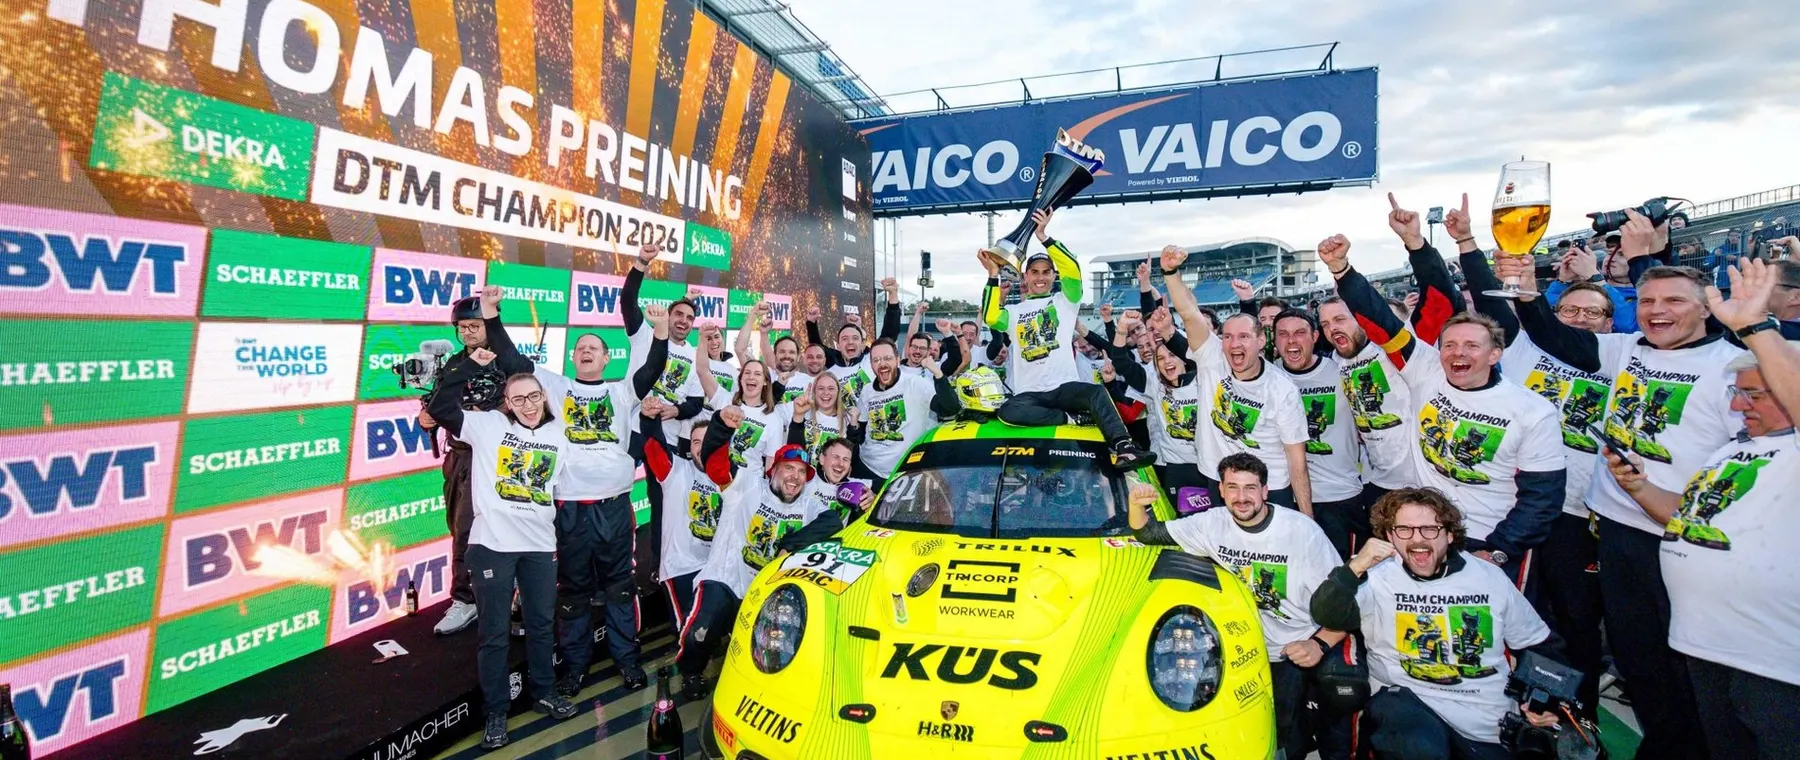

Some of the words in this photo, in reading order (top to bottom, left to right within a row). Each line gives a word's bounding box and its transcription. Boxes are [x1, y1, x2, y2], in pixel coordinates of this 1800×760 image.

[47, 0, 534, 157] HOMAS
[547, 104, 742, 220] PREINING
[182, 126, 286, 170] DEKRA
[1119, 110, 1342, 174] VAICO
[1127, 178, 1155, 187] Powered
[1157, 177, 1165, 185] by
[1166, 175, 1199, 184] VIEROL
[333, 148, 441, 210] DTM
[452, 177, 622, 244] CHAMPION
[627, 217, 679, 254] 2026
[701, 241, 726, 257] DEKRA
[0, 229, 185, 294] BWT
[216, 264, 360, 291] SCHAEFFLER
[384, 265, 477, 306] BWT
[235, 346, 327, 363] CHANGE
[256, 363, 328, 377] WORLD
[1175, 398, 1198, 406] CHAMP
[1231, 393, 1264, 409] AMPION
[744, 417, 767, 429] AMPION
[367, 417, 432, 460] BW
[190, 438, 341, 474] SCHAEFFLER
[991, 446, 1035, 456] DTM
[1048, 449, 1096, 459] PREINING
[0, 446, 155, 517] WT
[886, 473, 923, 503] 91
[350, 495, 446, 530] SCHAEFFLE
[185, 510, 328, 587] BWT
[807, 541, 876, 565] DEKRA
[954, 541, 1077, 558] TRILUX
[1218, 545, 1240, 557] TEAM
[801, 552, 844, 575] 91
[1232, 558, 1252, 566] 2026
[781, 568, 833, 586] ADAC
[348, 555, 448, 625] BWT
[1394, 593, 1427, 604] TEAM
[1429, 594, 1489, 605] CHAMPION
[939, 605, 1015, 620] WORKWEAR
[1396, 603, 1418, 612] DTM
[1419, 605, 1444, 614] 2026
[160, 610, 321, 680] SCHAEFFLER
[880, 642, 1042, 690] KÜS
[1231, 647, 1260, 669] PADDOCK
[13, 661, 125, 741] WT
[1233, 678, 1259, 702] ENDLESS
[734, 694, 803, 744] VELTINS
[917, 721, 952, 739] H&R
